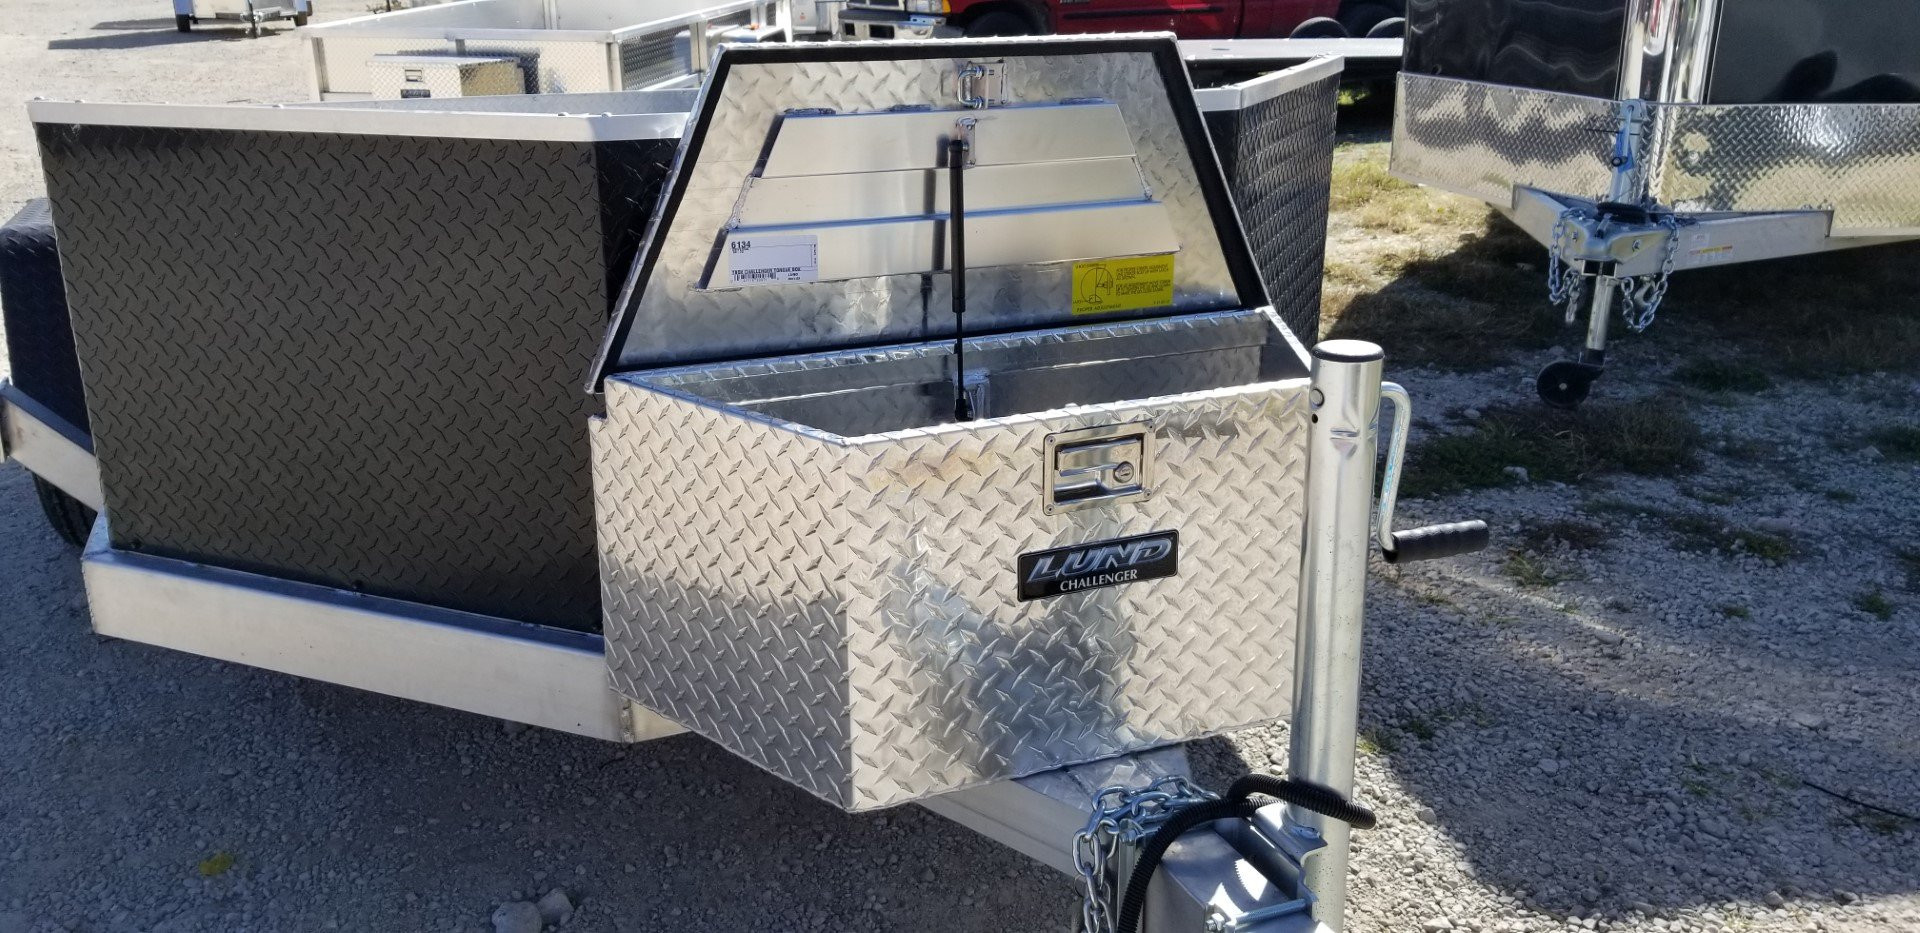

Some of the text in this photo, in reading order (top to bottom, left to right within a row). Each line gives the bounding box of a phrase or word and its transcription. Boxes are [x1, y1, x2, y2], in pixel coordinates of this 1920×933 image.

[731, 240, 751, 249] 6134
[1027, 537, 1173, 583] LUND
[1060, 568, 1138, 592] CHALLENGER
